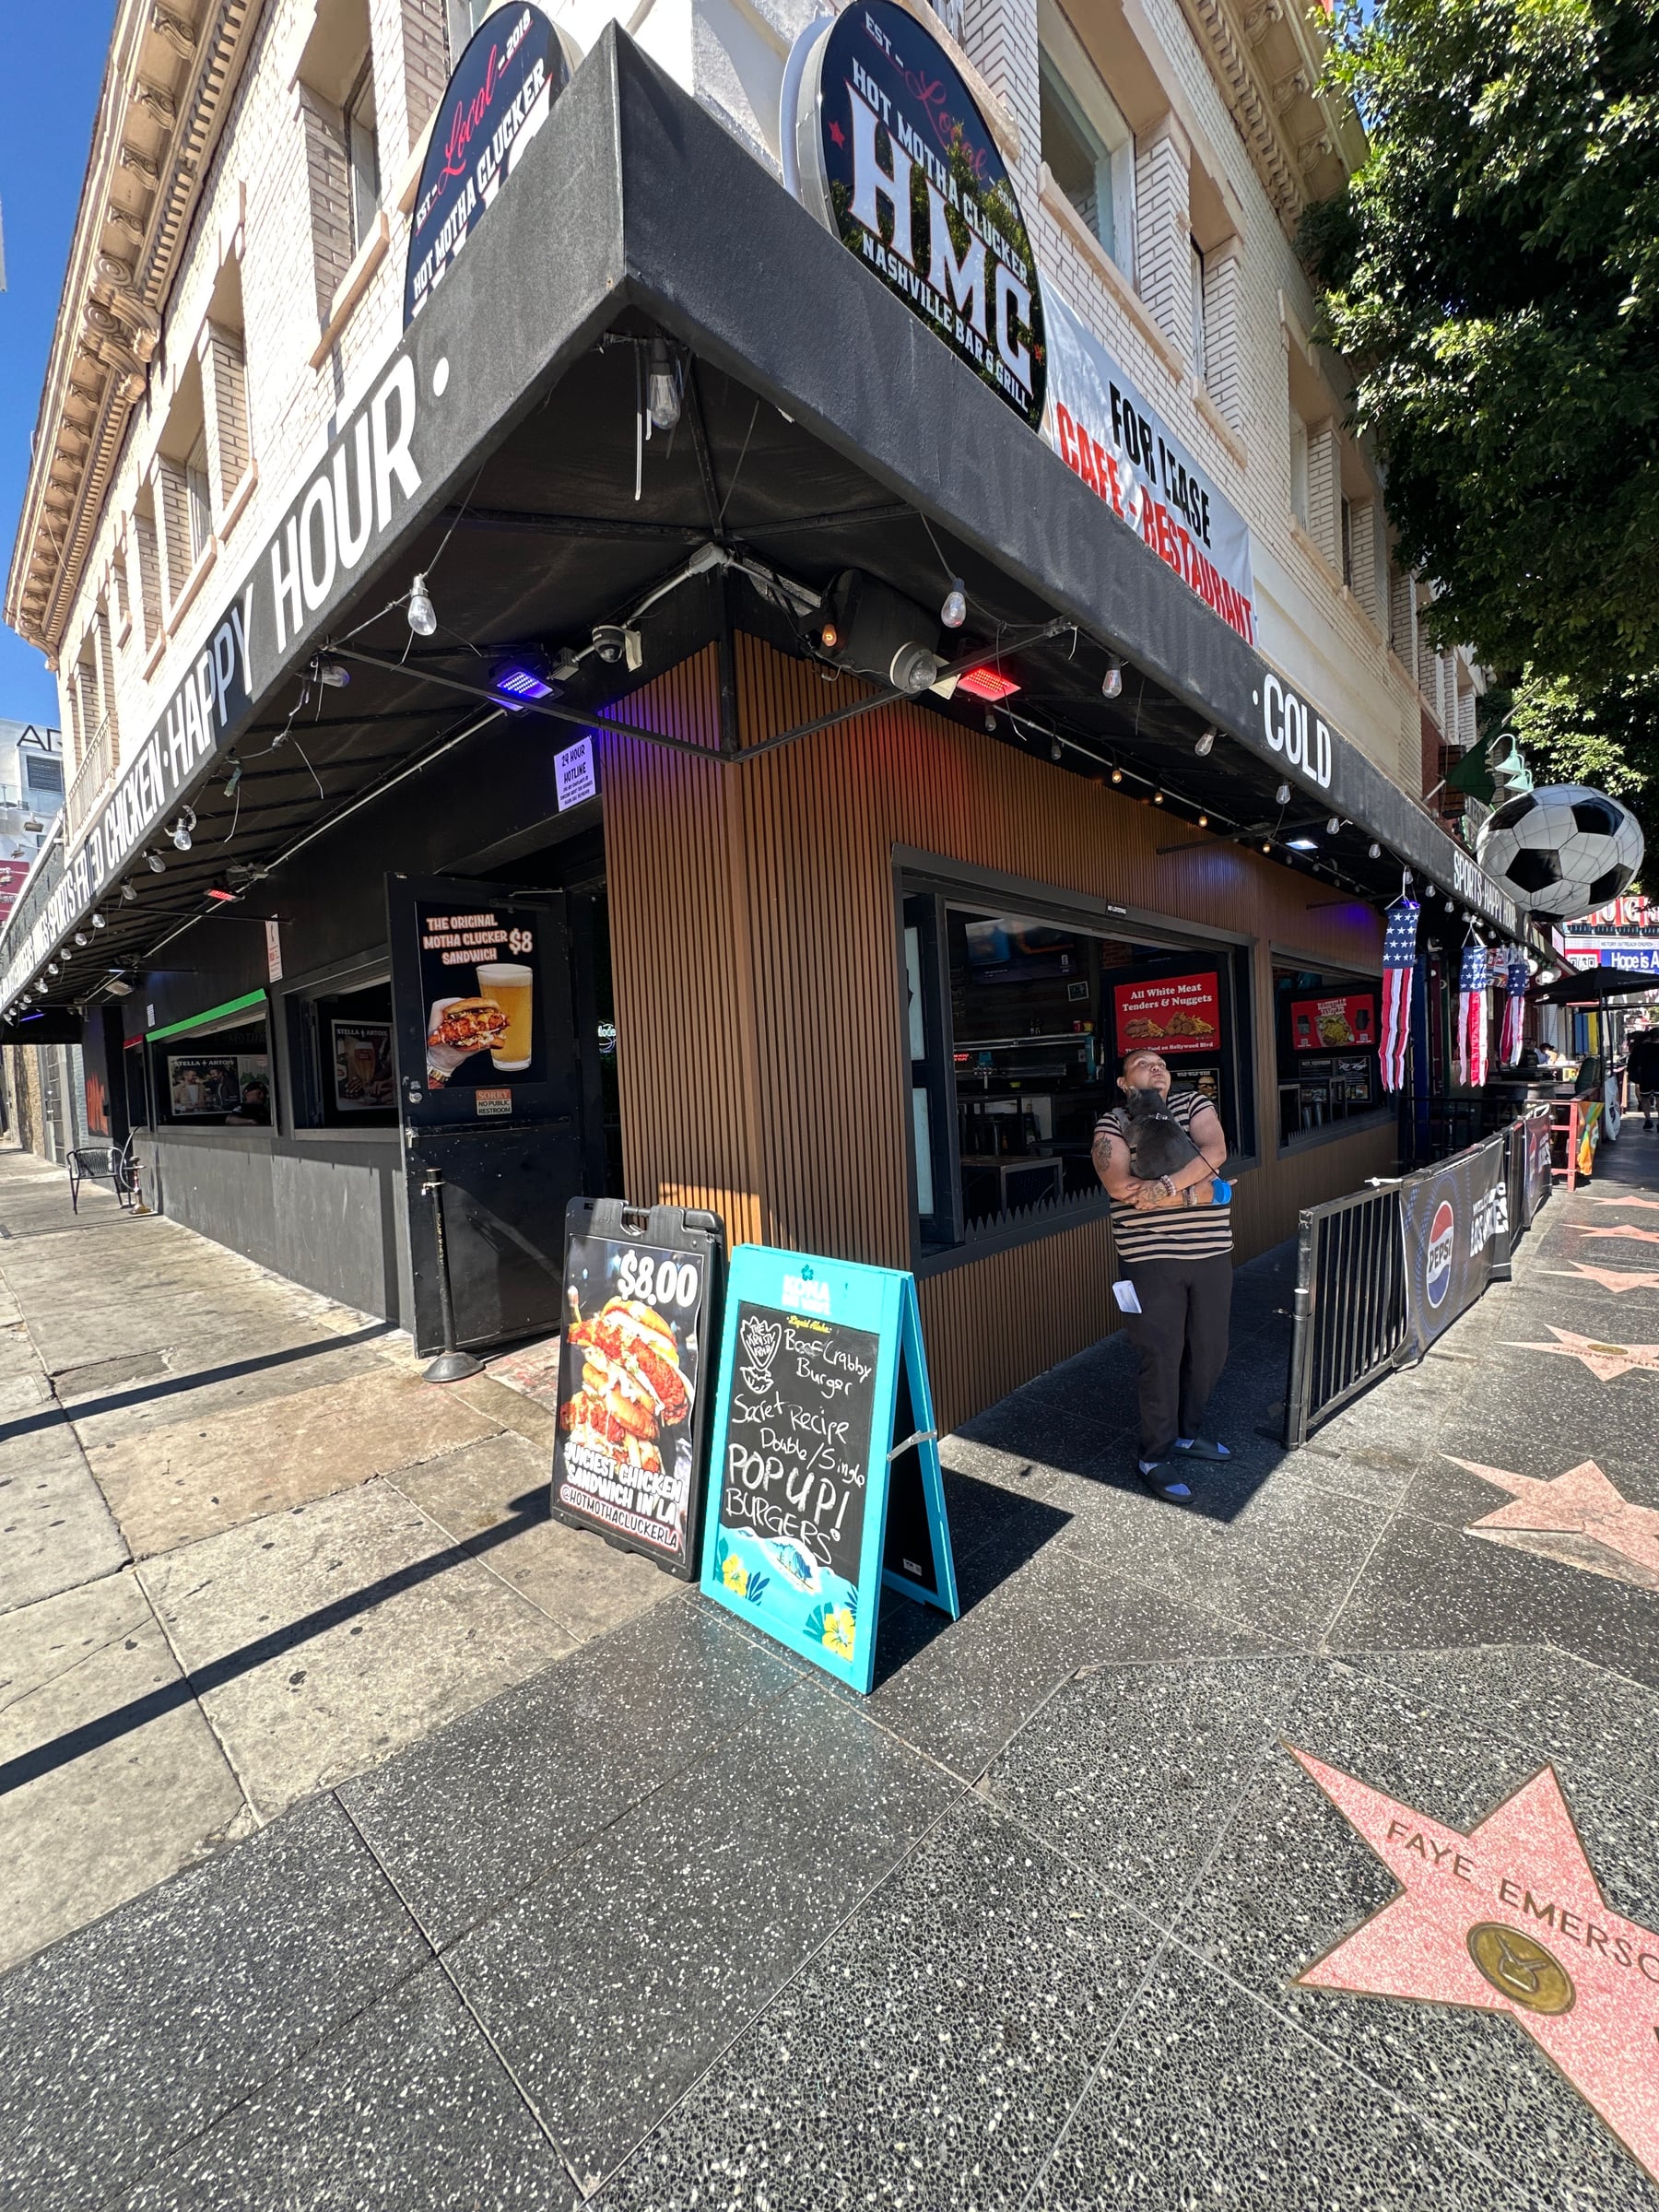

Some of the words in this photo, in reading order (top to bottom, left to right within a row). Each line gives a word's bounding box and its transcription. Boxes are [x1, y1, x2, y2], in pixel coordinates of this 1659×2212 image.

[865, 12, 892, 57] EST
[416, 191, 431, 229] EST
[438, 44, 498, 195] Local
[506, 8, 531, 59] 2018
[413, 249, 433, 300] HOT
[434, 177, 477, 266] MOTHA
[476, 57, 546, 194] CLUCKER
[851, 56, 892, 126] HOT
[897, 111, 960, 212] MOTHA
[963, 192, 1028, 285] CLUCKER
[844, 78, 1035, 399] HMC
[862, 231, 953, 333] NASHVILLE
[955, 312, 984, 360] BAR
[984, 349, 995, 375] &
[995, 359, 1029, 414] GRILL
[1109, 380, 1158, 486] FOR
[1159, 435, 1212, 550] LEASE
[1056, 400, 1125, 521] CAFE
[1140, 484, 1254, 647] RESTAURANT
[75, 826, 104, 910] FRIED
[103, 731, 167, 869] CHICKEN
[168, 582, 255, 787] HAPPY
[270, 353, 423, 655] HOUR
[561, 753, 570, 767] 24
[570, 744, 585, 762] HOUR
[1264, 673, 1332, 789] COLD
[563, 762, 586, 784] HOTLINE
[1453, 850, 1483, 907] SPORTS
[1484, 878, 1503, 923] HAPPY
[423, 934, 461, 949] MOTHA
[463, 930, 508, 947] CLUCKER
[426, 917, 450, 932] THE
[450, 913, 499, 930] ORIGINAL
[509, 928, 534, 955] $8
[441, 947, 499, 965] SANDWICH
[1611, 952, 1640, 971] Hope
[1641, 952, 1649, 969] is
[1122, 1000, 1159, 1012] Tenders
[1161, 998, 1170, 1006] &
[1171, 994, 1212, 1006] Nuggets
[1131, 990, 1145, 1000] All
[1147, 987, 1175, 997] White
[1178, 983, 1202, 993] Meat
[1169, 1042, 1199, 1051] Hollywood
[478, 1090, 510, 1100] SORRY
[617, 1249, 698, 1308] $8.00
[1429, 1237, 1453, 1274] PEPSI
[748, 1324, 765, 1335] THE
[796, 1356, 853, 1399] Burger
[822, 1341, 872, 1383] Crabby
[731, 1390, 789, 1424] Secret
[787, 1404, 850, 1445] Recipe
[759, 1427, 807, 1461] Double
[563, 1441, 618, 1480] JUICIEST
[618, 1462, 684, 1504] CHICKEN
[567, 1462, 634, 1510] SANDWICH
[635, 1490, 655, 1517] IN
[656, 1497, 677, 1526] LA
[728, 1442, 784, 1492] POP
[785, 1466, 851, 1543] UP!
[561, 1485, 678, 1549] @HOTMOTHACLUCKERLA
[725, 1487, 832, 1566] BURGERS
[1386, 1818, 1477, 1884] FAYE
[1499, 1877, 1659, 1984] EMERSO
